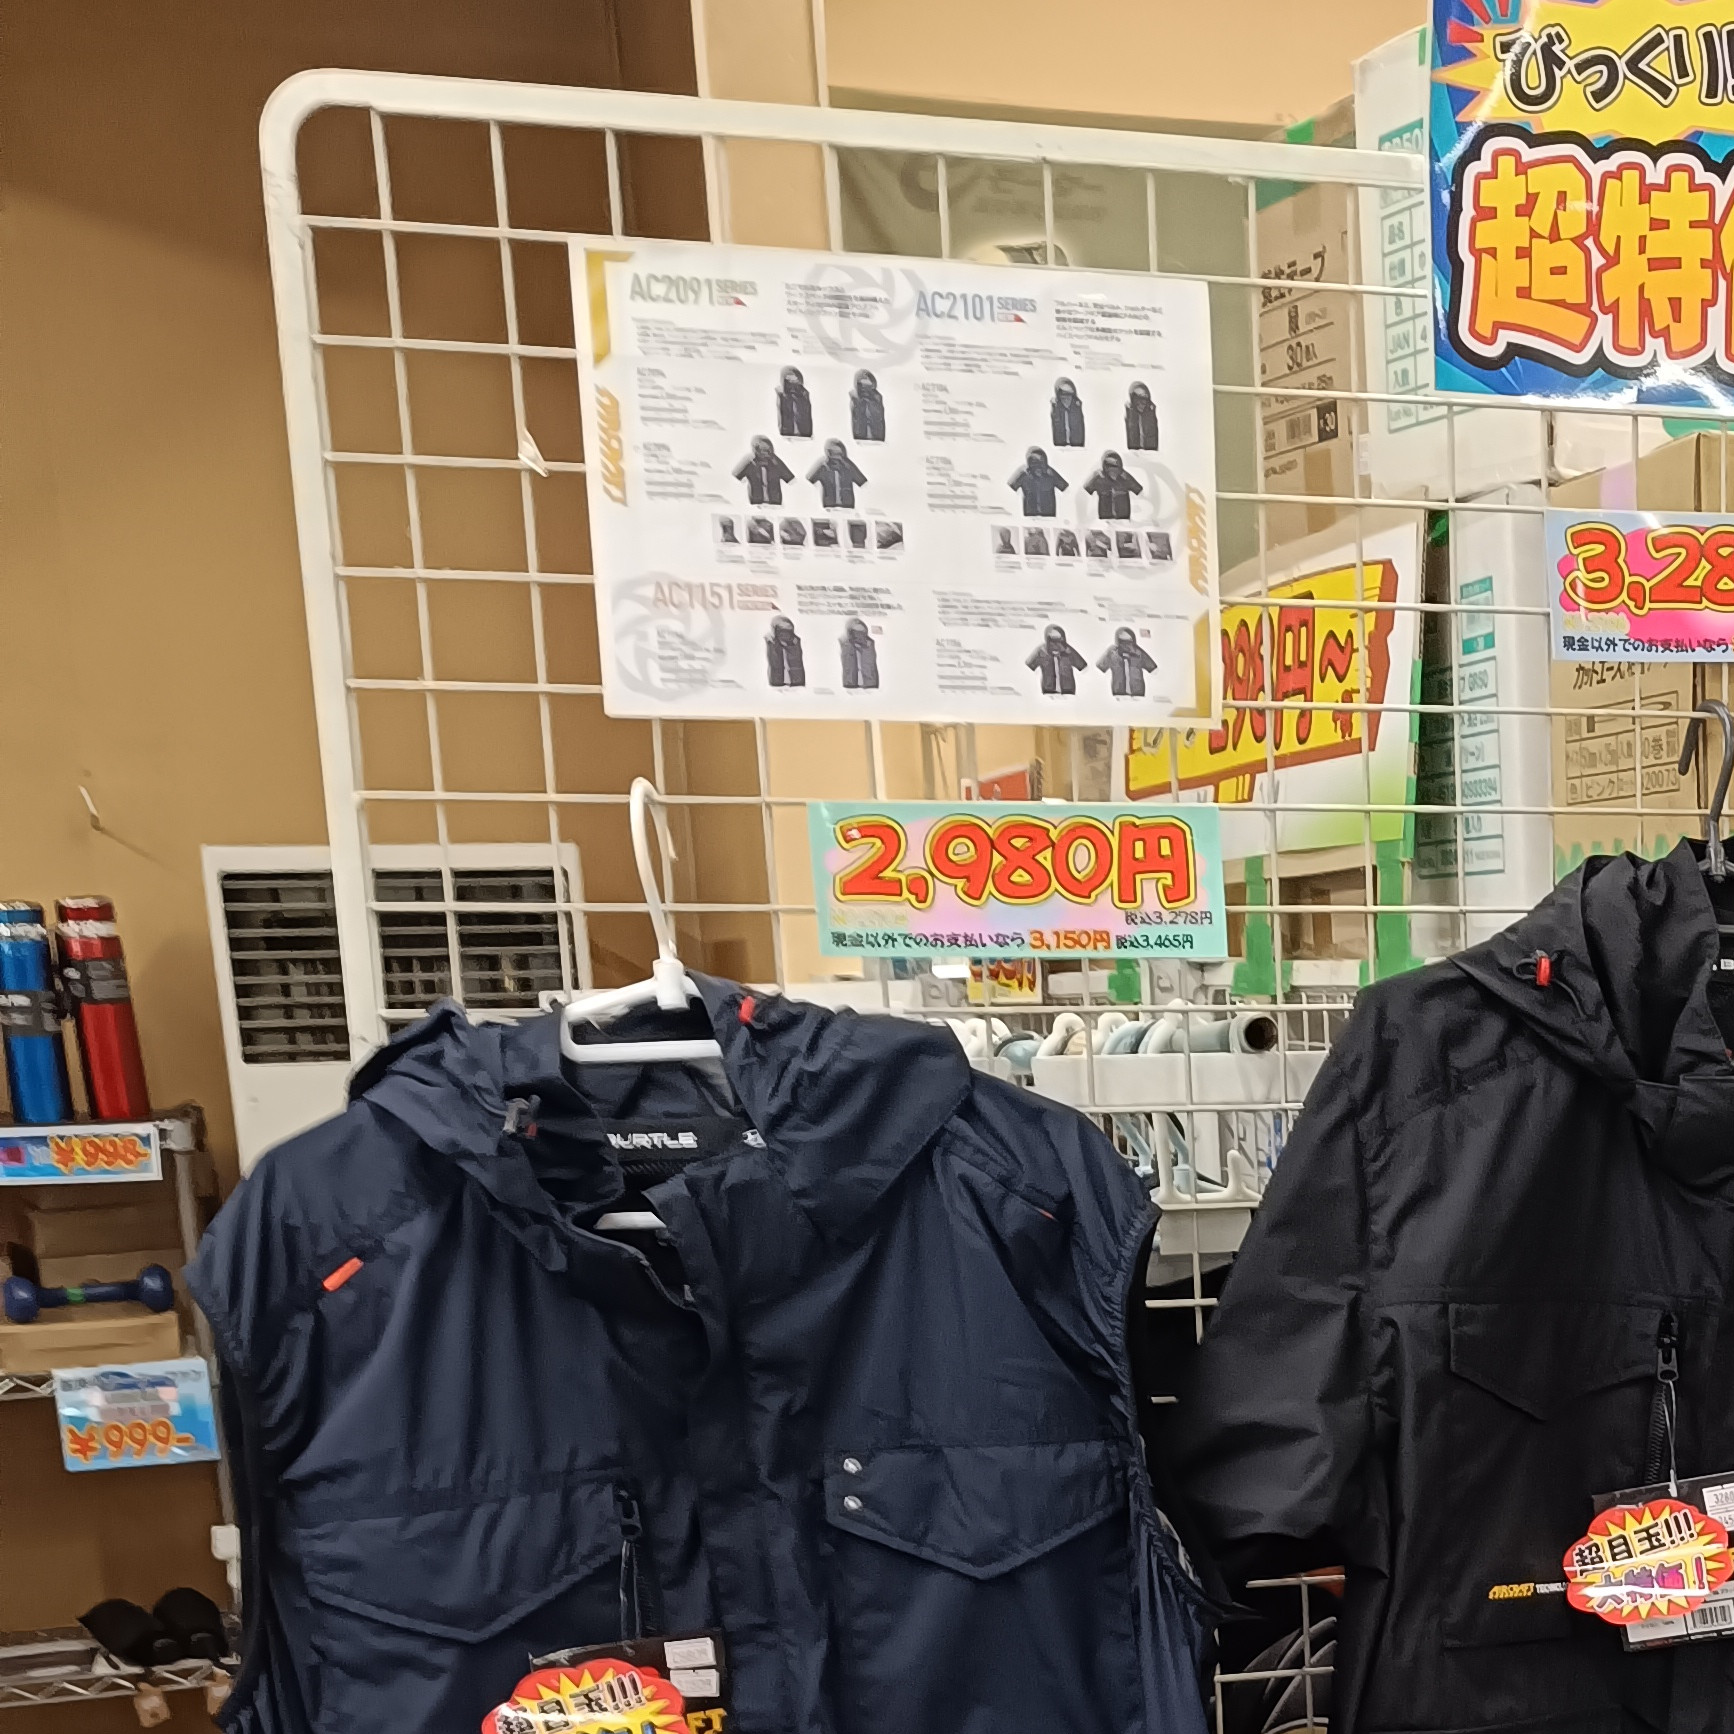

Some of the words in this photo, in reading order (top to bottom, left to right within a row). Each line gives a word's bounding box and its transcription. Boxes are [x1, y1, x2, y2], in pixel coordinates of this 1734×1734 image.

[916, 290, 996, 322] AC2101
[833, 814, 1197, 911] 2,980円
[1028, 928, 1112, 951] 3,150円
[1574, 1509, 1699, 1577] 超目玉!!!
